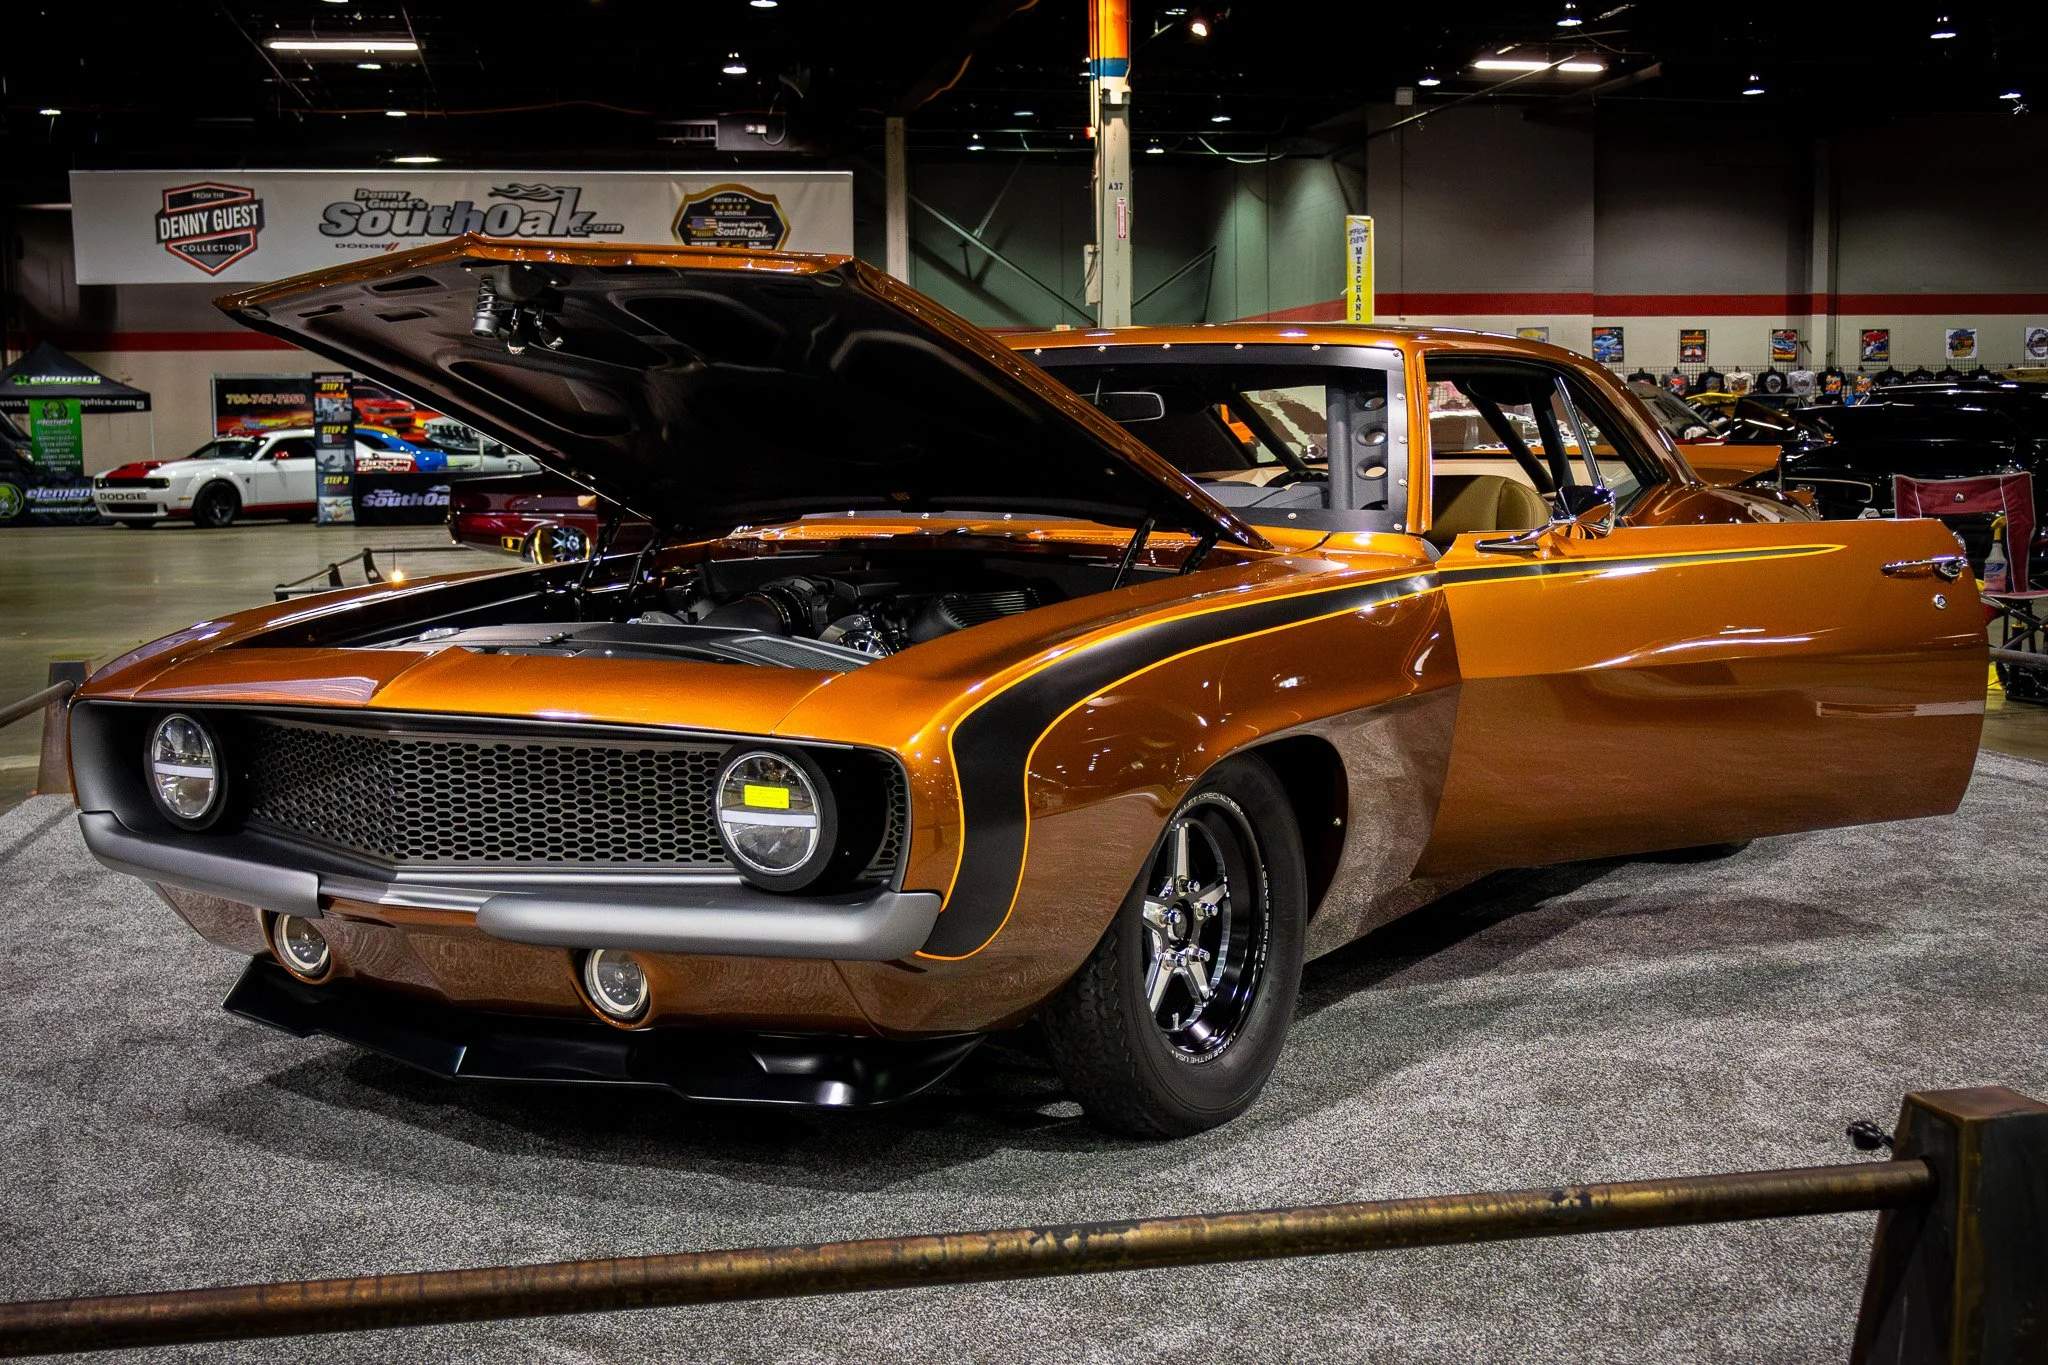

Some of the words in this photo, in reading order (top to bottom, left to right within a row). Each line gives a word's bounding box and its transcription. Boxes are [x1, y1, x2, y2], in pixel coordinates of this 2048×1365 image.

[1108, 182, 1124, 191] A37
[354, 188, 411, 201] Denny
[365, 198, 429, 211] Guest's
[160, 211, 209, 240] DENNY
[213, 204, 259, 232] GUEST
[718, 221, 739, 229] Denny
[716, 226, 748, 237] South
[181, 244, 242, 252] COLLECTION
[30, 374, 102, 385] element
[321, 382, 339, 391] STEP
[322, 425, 341, 434] STEP
[324, 476, 343, 485] STEP
[100, 492, 148, 501] DODGE
[361, 486, 450, 507] SouthOa
[1198, 792, 1241, 813] SPECIALTIES
[1213, 1035, 1233, 1057] MADE
[1175, 1051, 1190, 1063] USA
[1190, 1056, 1205, 1064] THE
